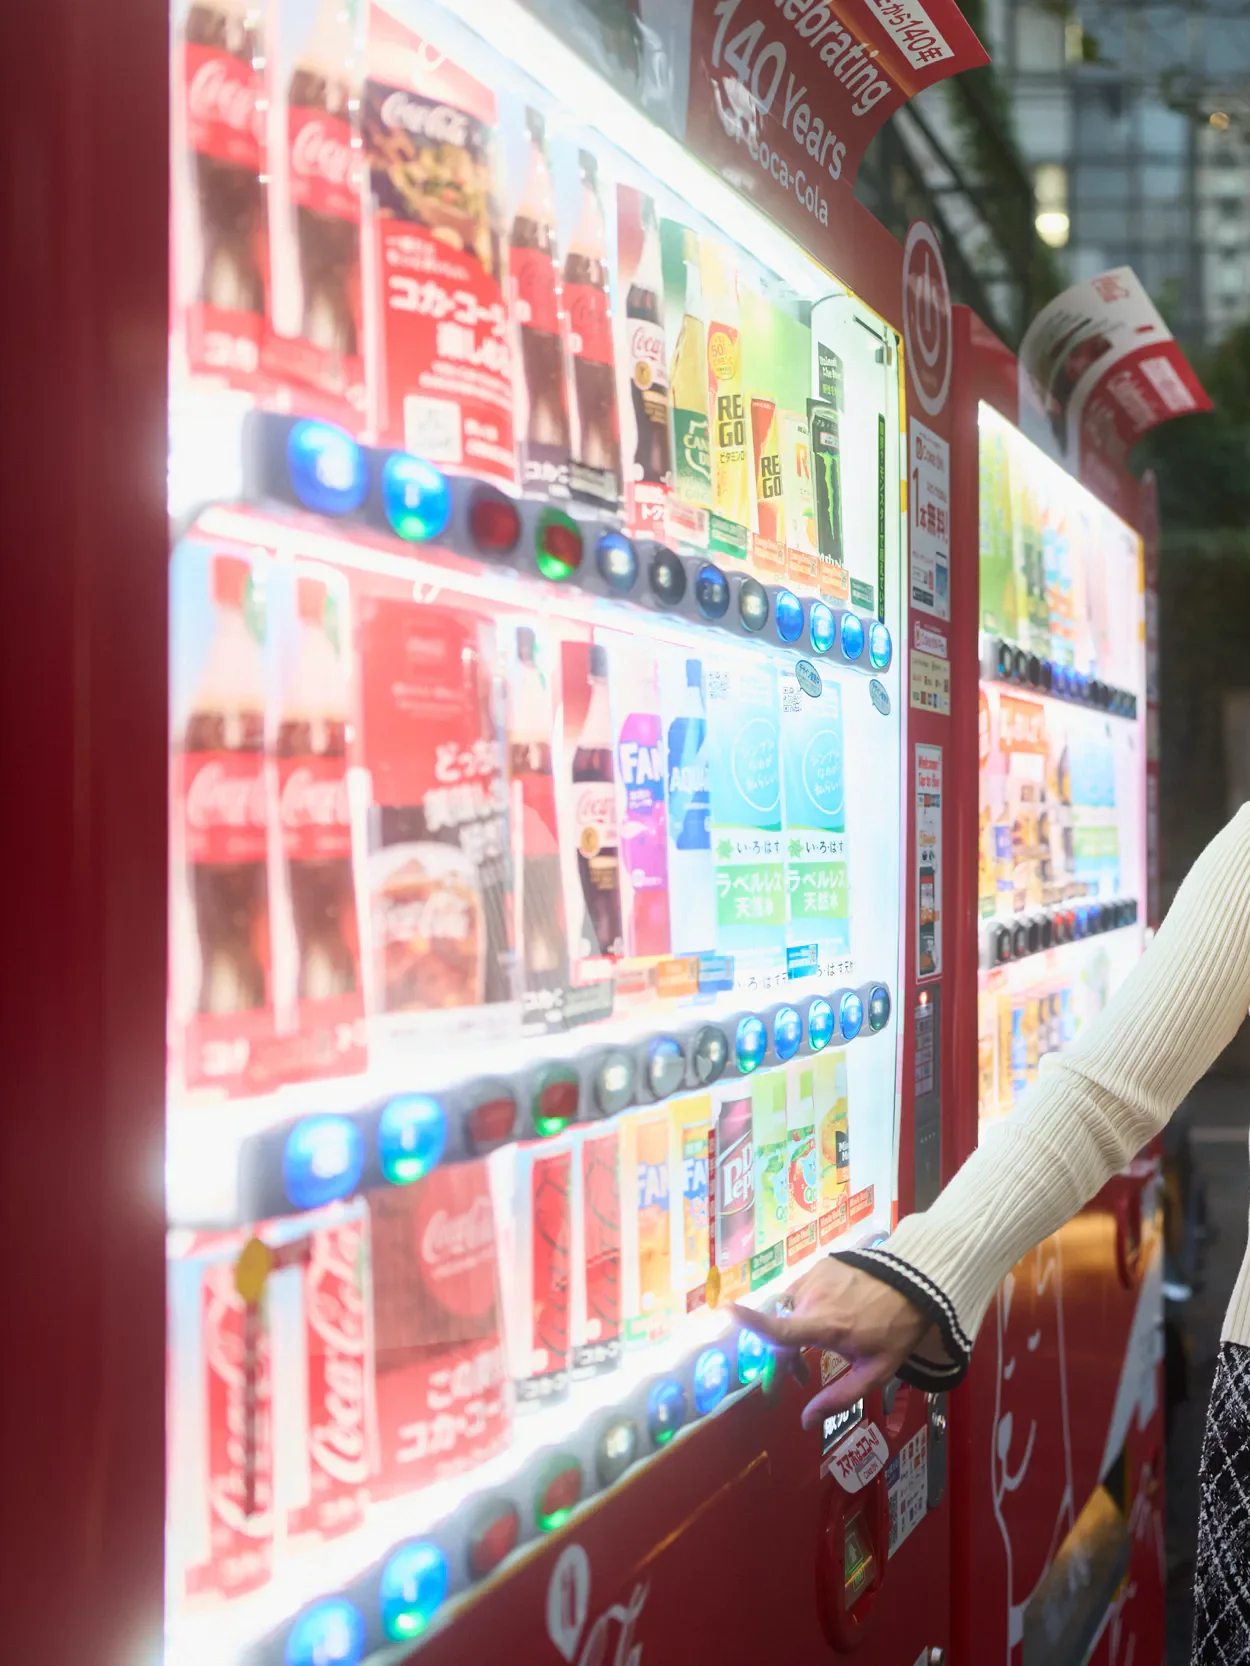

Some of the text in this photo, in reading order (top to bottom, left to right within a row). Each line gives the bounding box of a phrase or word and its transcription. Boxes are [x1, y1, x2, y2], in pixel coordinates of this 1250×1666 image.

[712, 0, 846, 180] 140 Years
[748, 127, 828, 227] Coca-Cola
[716, 871, 783, 897] ラベルレス
[787, 870, 845, 893] ラベルレス
